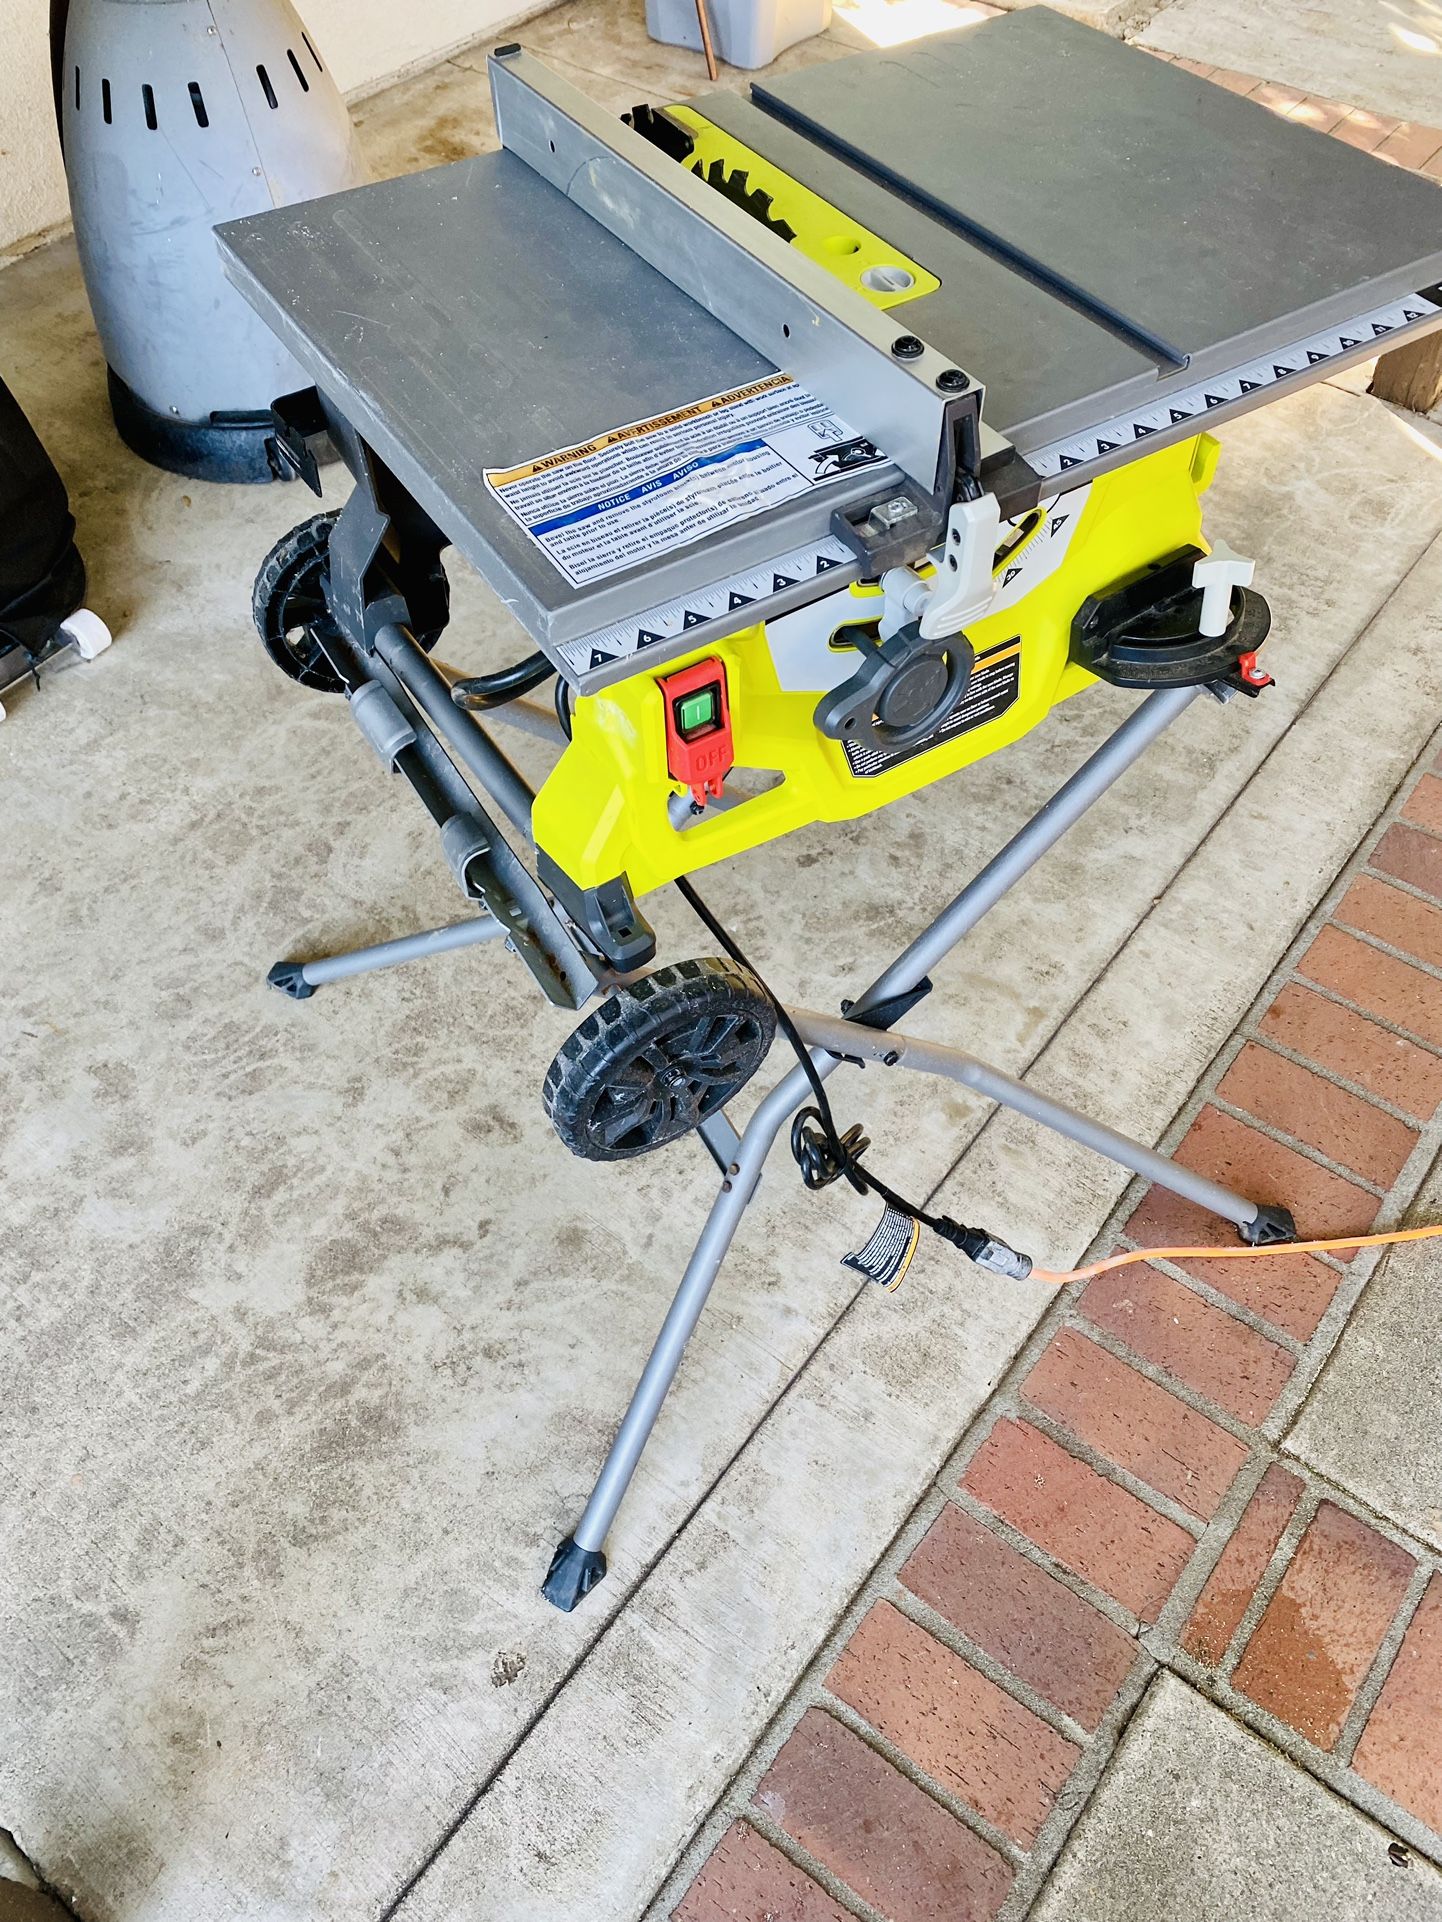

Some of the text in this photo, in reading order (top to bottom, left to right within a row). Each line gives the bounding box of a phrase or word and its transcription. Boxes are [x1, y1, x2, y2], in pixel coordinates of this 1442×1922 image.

[541, 374, 790, 468] WARNING AVERTISSEMENT ADVERTENCIA
[1063, 458, 1072, 466] 2
[1311, 352, 1319, 360] 9
[1343, 339, 1354, 347] 10
[499, 483, 517, 493] Never
[518, 476, 541, 487] operate
[598, 444, 624, 457] Securely
[504, 490, 521, 498] waist
[521, 482, 540, 493] height
[547, 474, 564, 483] avoid
[591, 453, 621, 468] operations
[621, 446, 638, 455] which
[597, 461, 699, 510] NOTICE AVIS AVISO
[545, 532, 564, 542] Bevel
[591, 517, 604, 525] and
[605, 508, 630, 520] remove
[641, 489, 673, 506] styrofoam
[699, 465, 726, 479] between
[569, 559, 587, 569] Bisel
[596, 549, 616, 559] sierra
[622, 539, 641, 549] retire
[649, 523, 680, 539] empaque
[679, 504, 718, 526] protector(s)
[775, 476, 792, 485] entre
[1053, 518, 1062, 530] 45
[549, 539, 563, 547] and
[563, 532, 581, 542] table
[581, 527, 598, 536] prior
[566, 543, 581, 551] scie
[590, 531, 613, 543] biseau
[621, 520, 642, 530] retirer
[572, 546, 595, 557] moteur
[611, 532, 628, 541] table
[629, 525, 647, 535] avant
[575, 558, 614, 576] alojamiento
[614, 552, 626, 560] del
[626, 545, 646, 555] motor
[660, 532, 679, 542] mesa
[1006, 570, 1016, 580] 30
[594, 560, 830, 662] 7 6 5 4 3 2
[695, 745, 727, 772] OFF
